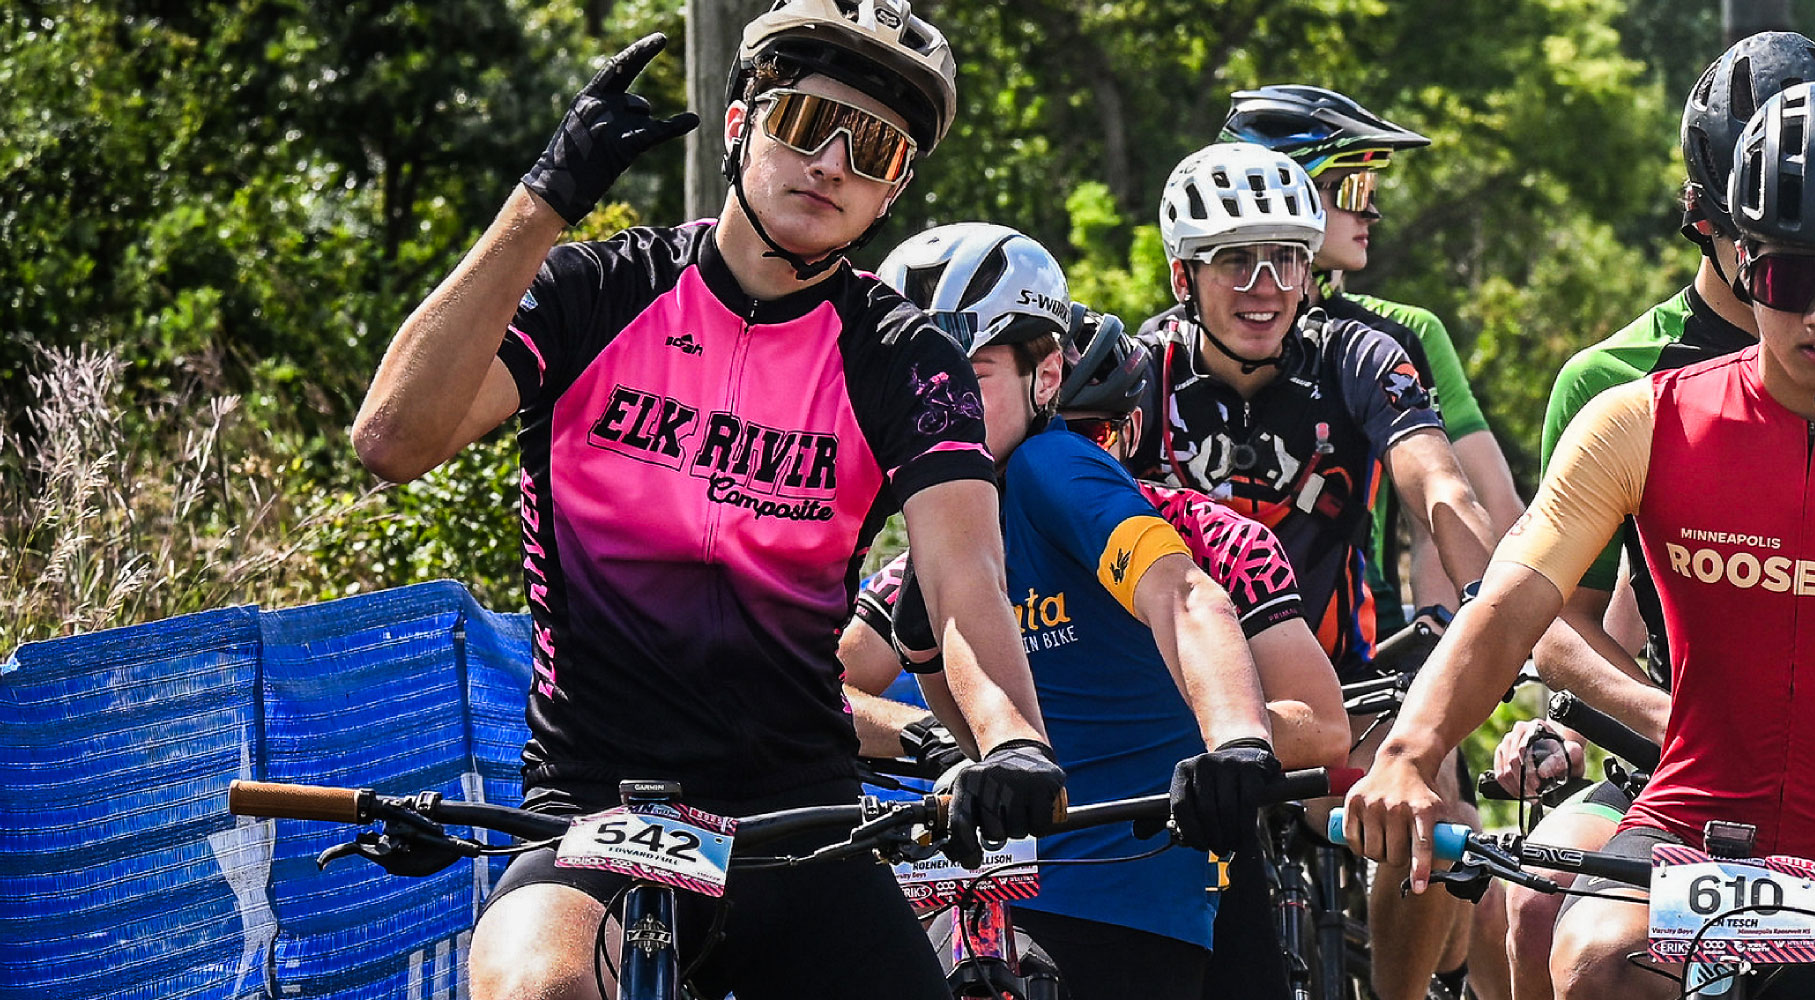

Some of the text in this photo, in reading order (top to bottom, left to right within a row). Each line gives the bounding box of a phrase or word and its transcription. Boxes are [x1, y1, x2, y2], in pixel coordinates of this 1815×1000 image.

[589, 385, 838, 499] ELK RIVER
[708, 472, 835, 521] Composite
[1681, 528, 1781, 549] MINNEAPOLIS
[1042, 625, 1079, 649] BIKE
[594, 821, 701, 863] 542
[1689, 874, 1783, 916] 610
[1652, 927, 1694, 935] Varsity Boys
[1727, 918, 1759, 928] TESCH
[1737, 928, 1773, 936] Minneapolis
[627, 929, 672, 944] YETI
